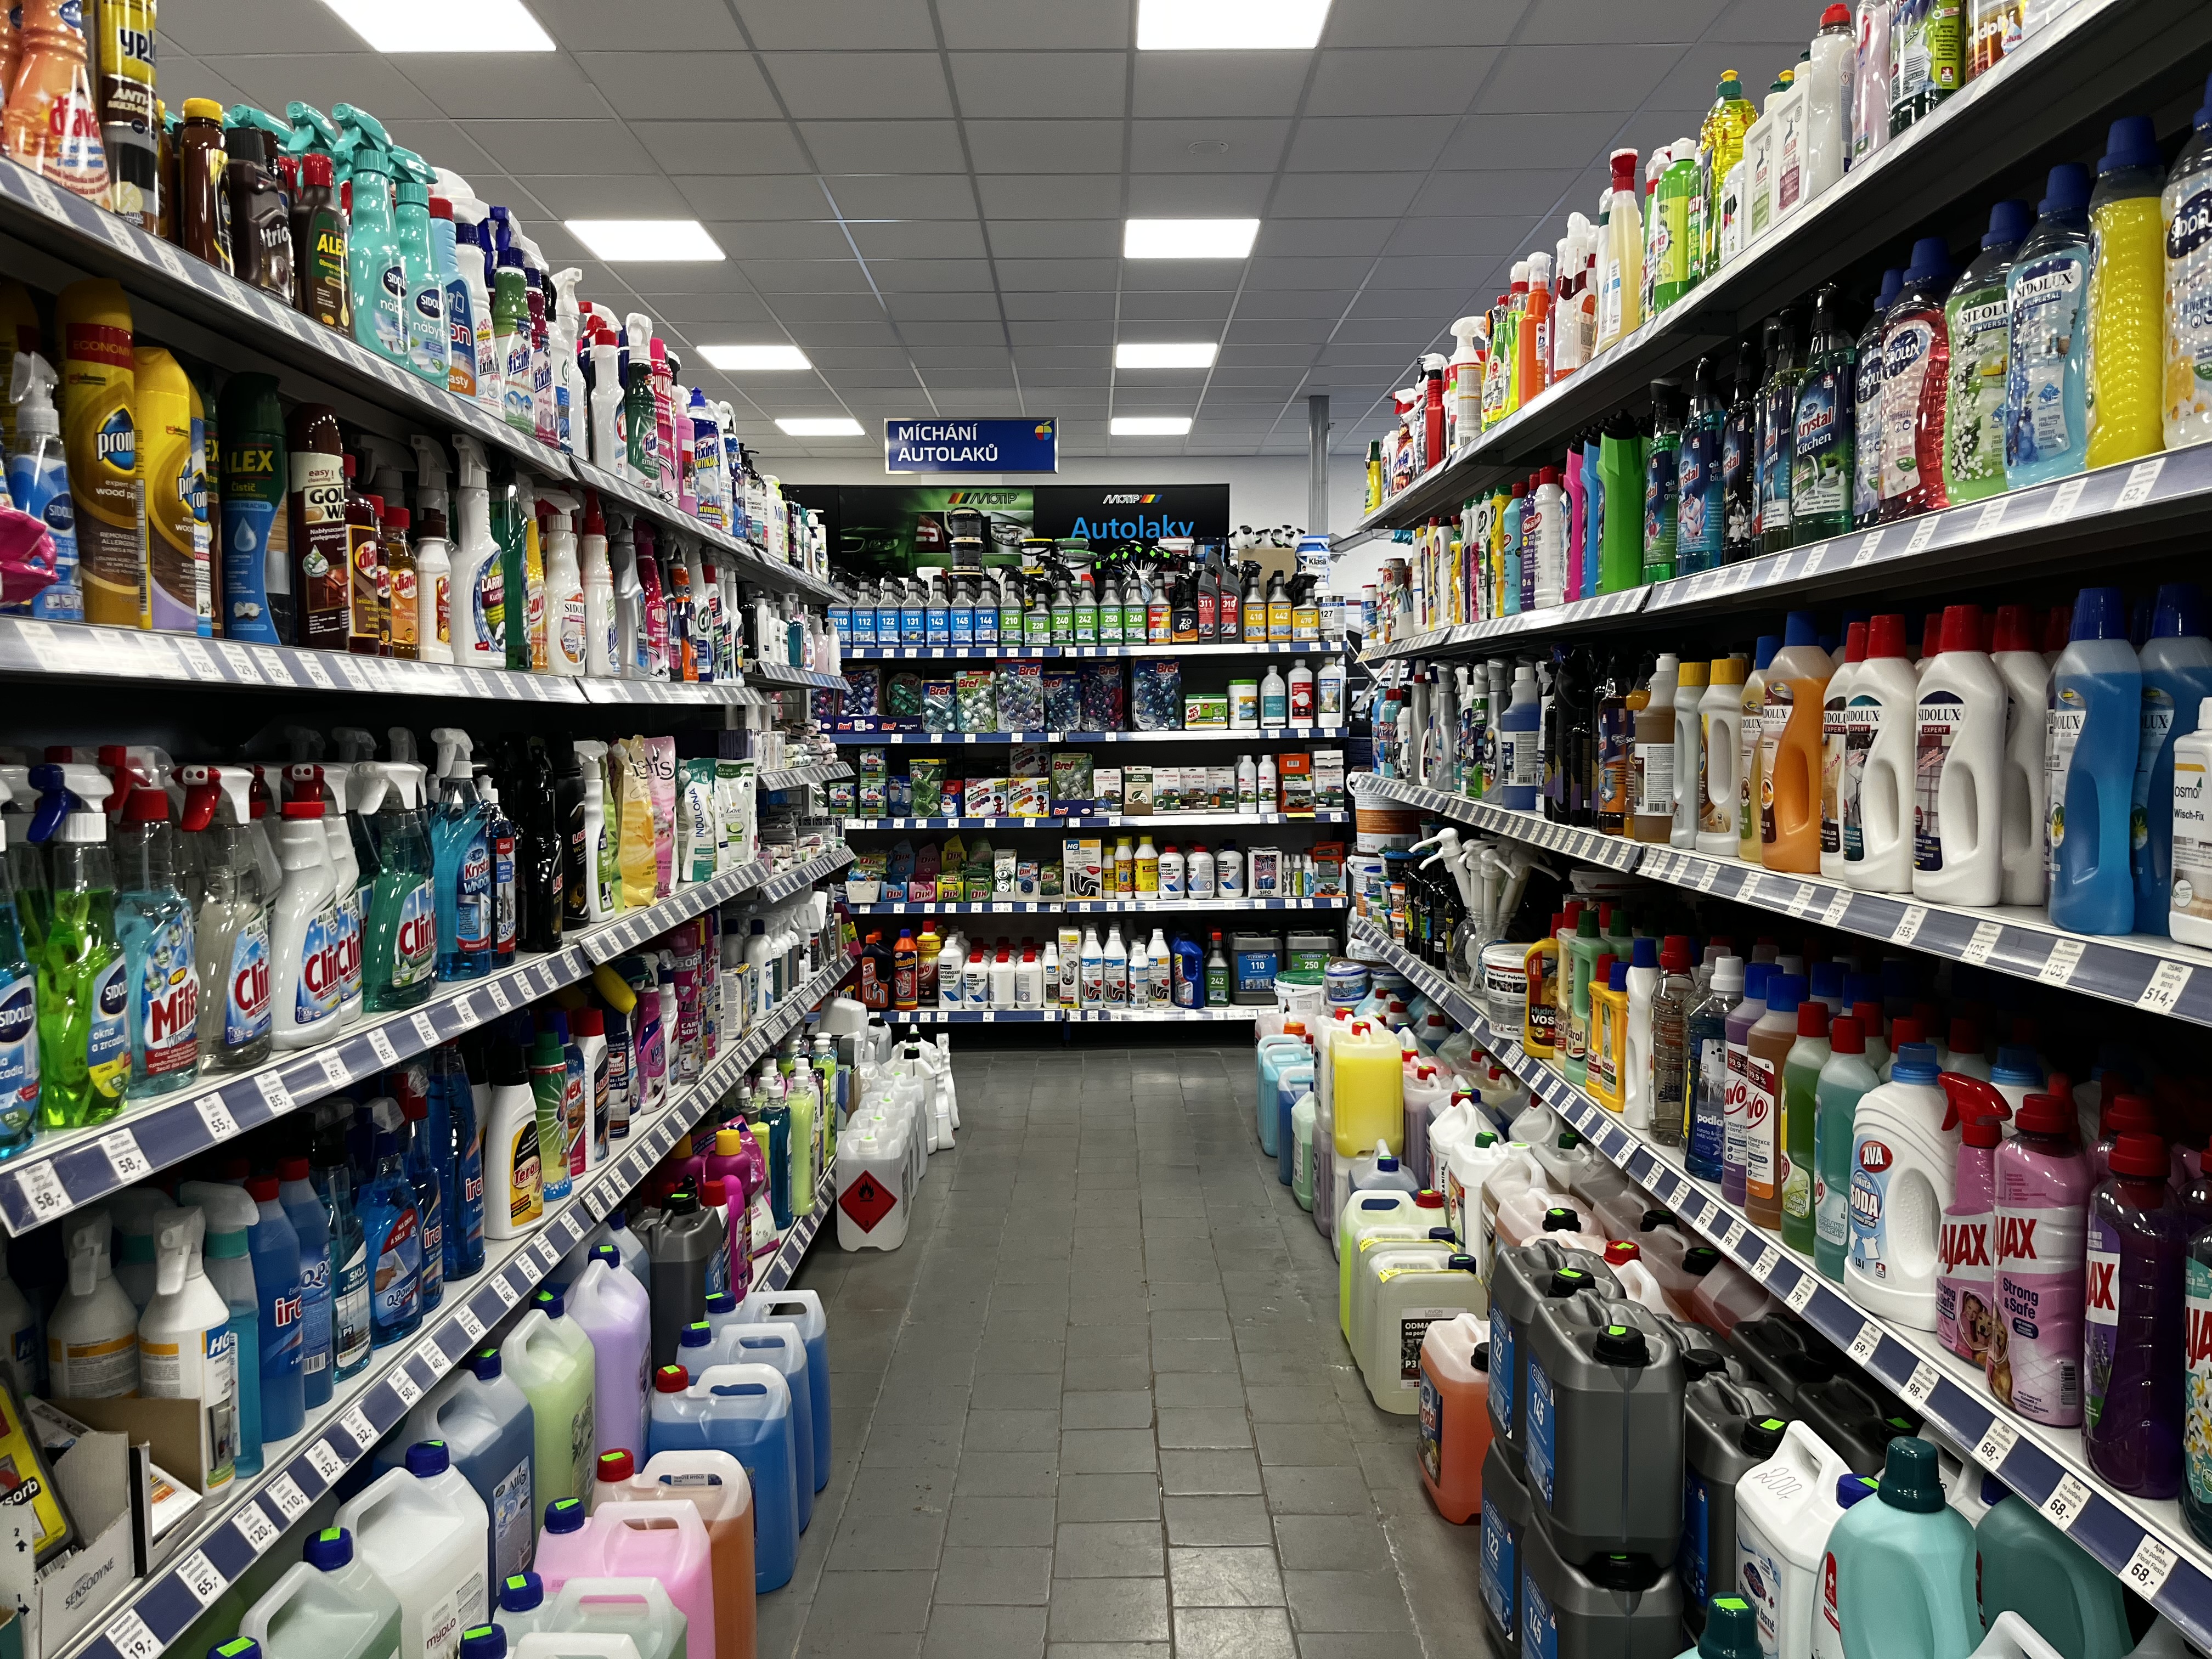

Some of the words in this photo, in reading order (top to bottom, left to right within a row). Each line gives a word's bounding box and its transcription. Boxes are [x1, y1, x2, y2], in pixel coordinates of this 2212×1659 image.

[2016, 273, 2072, 298] SIDOLUX
[2024, 292, 2060, 308] UNIVERSAL
[899, 423, 978, 441] MÍCHÁNÍ
[898, 443, 998, 462] AUTOLAKŮ
[1797, 433, 1832, 456] Kitchen
[970, 493, 1017, 504] MOTIP
[1103, 494, 1140, 504] MOTIP
[1222, 600, 1235, 608] 310
[980, 617, 992, 625] 146
[1018, 665, 1040, 675] Bref
[1157, 662, 1179, 673] Bref
[929, 686, 950, 695] Bref
[958, 678, 979, 687] Bref
[1918, 709, 1960, 721] SIDOLUX
[1054, 761, 1075, 770] Bref
[2175, 785, 2199, 800] osmo
[689, 788, 704, 838] INDULONA
[2174, 808, 2204, 821] Wisch-Fix
[399, 914, 433, 953] Clin
[1251, 961, 1264, 969] 110
[1305, 961, 1318, 969] 250
[2145, 988, 2174, 1005] 514,-
[93, 1027, 115, 1040] okna
[92, 1043, 98, 1052] a
[211, 1119, 230, 1131] 55,-
[1863, 1146, 1883, 1165] AVA
[119, 1158, 141, 1173] 58,-
[514, 1160, 541, 1187] Teron
[35, 1192, 61, 1210] 58,-
[1850, 1186, 1879, 1218] SODA
[1939, 1224, 1990, 1273] AJAX
[2003, 1278, 2039, 1307] Strong
[2004, 1297, 2035, 1319] &Safe
[343, 1325, 353, 1336] P9
[210, 1332, 230, 1356] HG
[1493, 1333, 1503, 1363] 122
[1405, 1360, 1417, 1368] P3
[1909, 1383, 1922, 1399] 98,-
[1533, 1392, 1544, 1425] 145
[1981, 1442, 1999, 1462] 68,-
[281, 1493, 305, 1514] 110,-
[2050, 1499, 2069, 1520] 68,-
[14, 1528, 20, 1537] 2
[249, 1524, 273, 1544] 120,-
[1487, 1527, 1498, 1561] 122
[65, 1556, 114, 1609] SENSODYNE
[2131, 1563, 2154, 1587] 68,-
[196, 1577, 218, 1596] 65,-
[1530, 1610, 1541, 1644] 145
